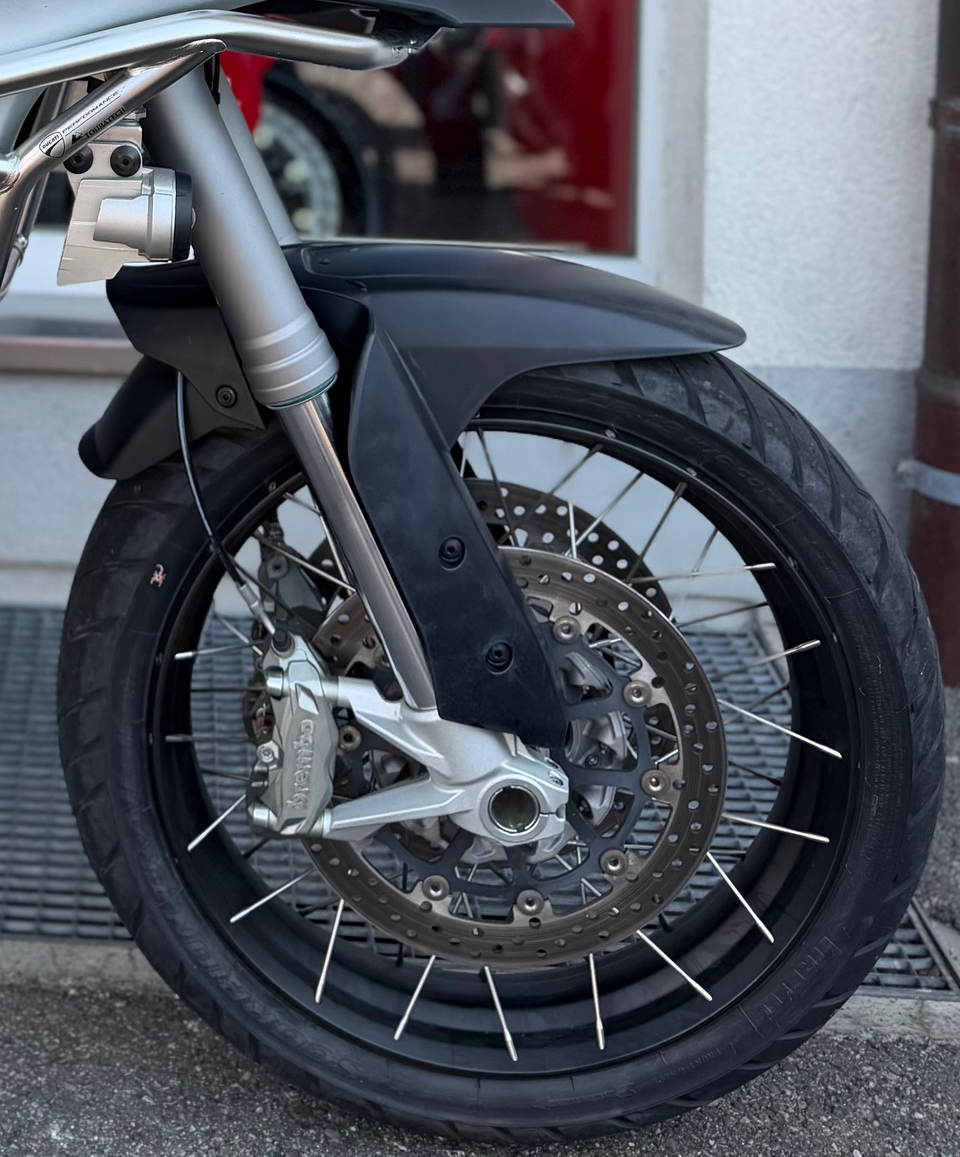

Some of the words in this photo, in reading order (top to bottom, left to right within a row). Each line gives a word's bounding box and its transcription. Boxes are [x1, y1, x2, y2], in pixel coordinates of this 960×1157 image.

[62, 90, 121, 133] PERFORMANCE
[85, 106, 126, 139] TOURATECH
[41, 134, 60, 150] DUCATI
[286, 718, 316, 810] brembo
